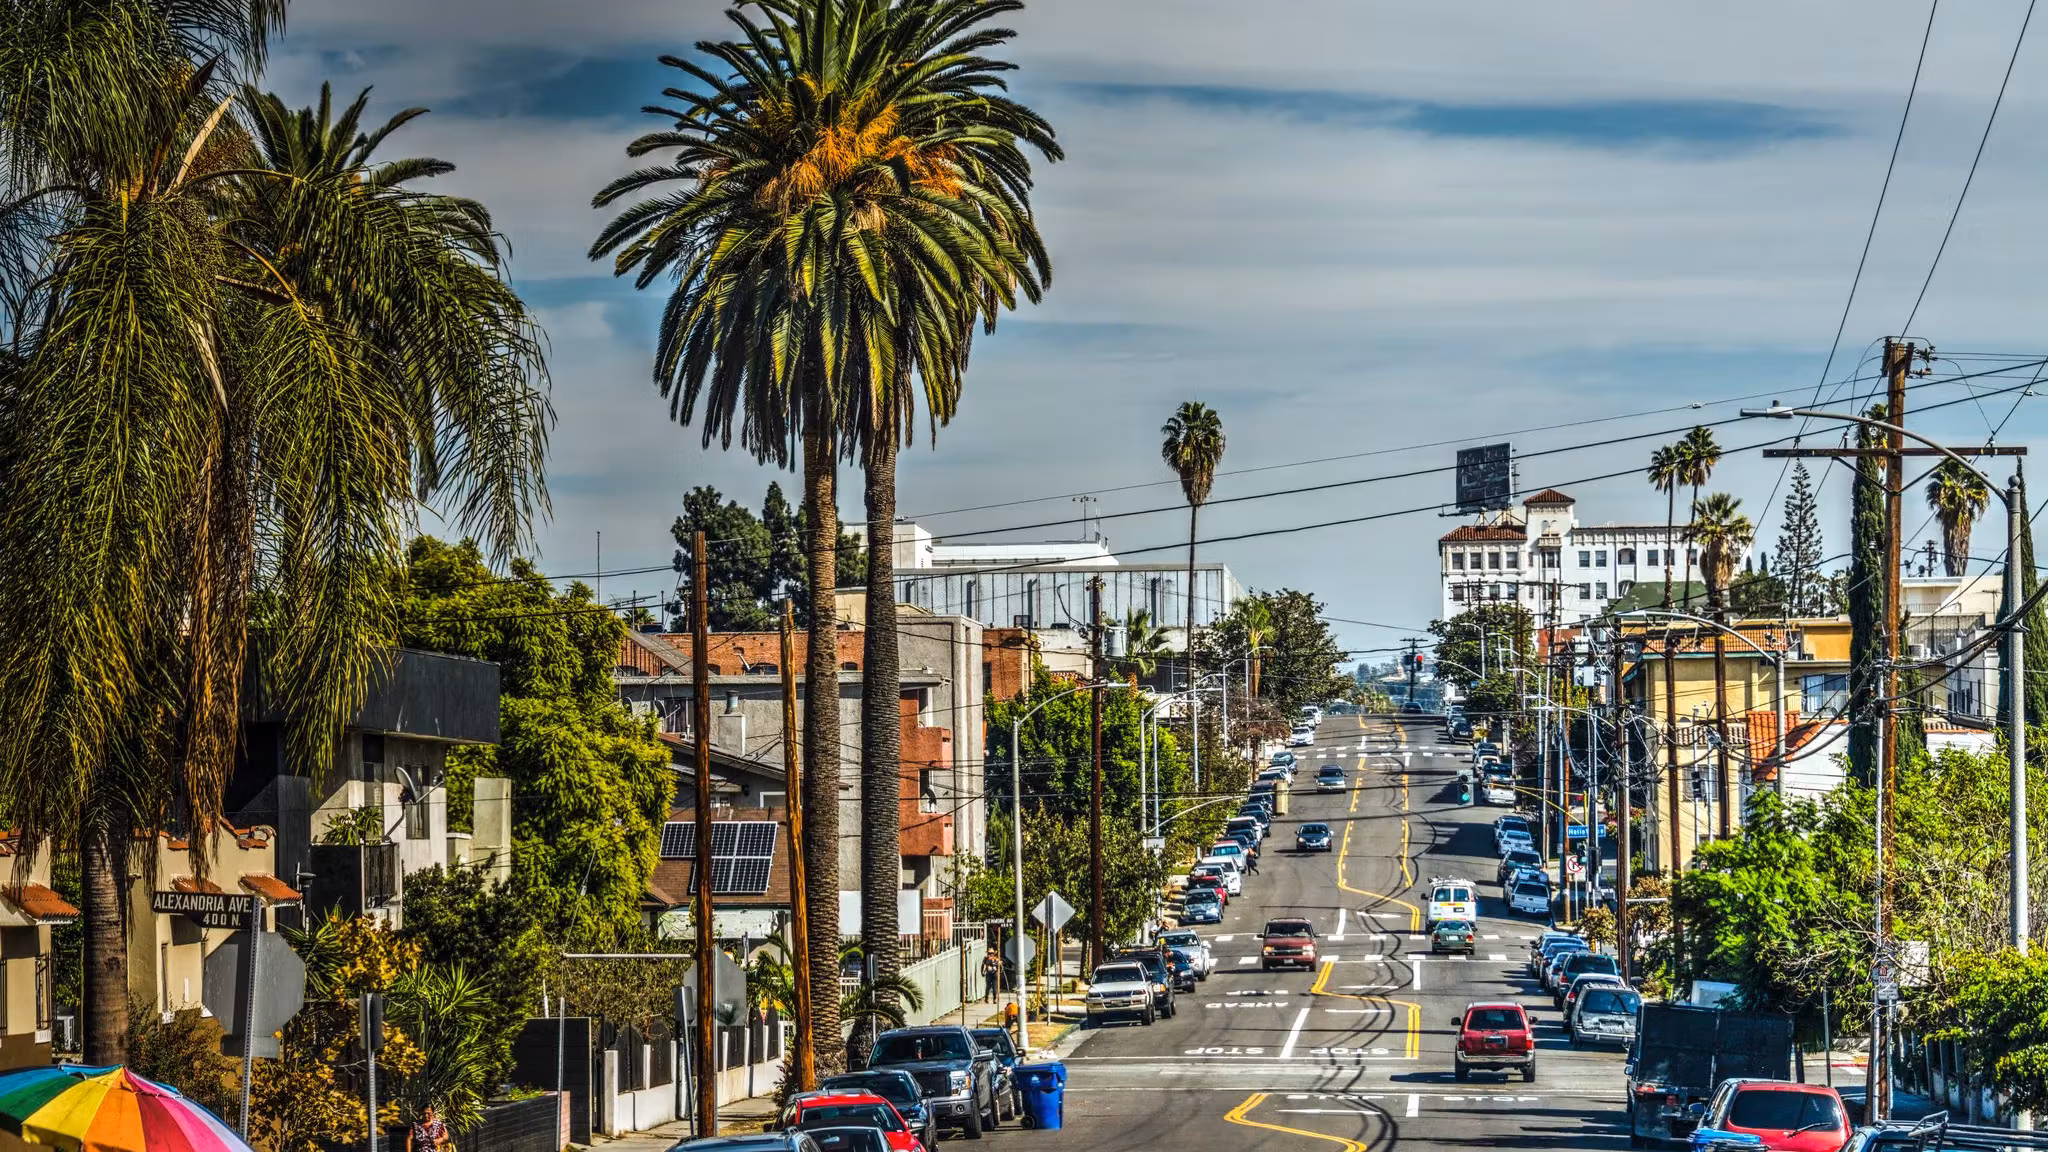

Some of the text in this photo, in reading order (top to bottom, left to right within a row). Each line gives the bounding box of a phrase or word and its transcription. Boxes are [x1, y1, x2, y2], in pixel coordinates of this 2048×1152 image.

[153, 894, 252, 913] ALEXANDRIA AVE.
[203, 913, 226, 926] 400
[1309, 1047, 1389, 1055] STOP
